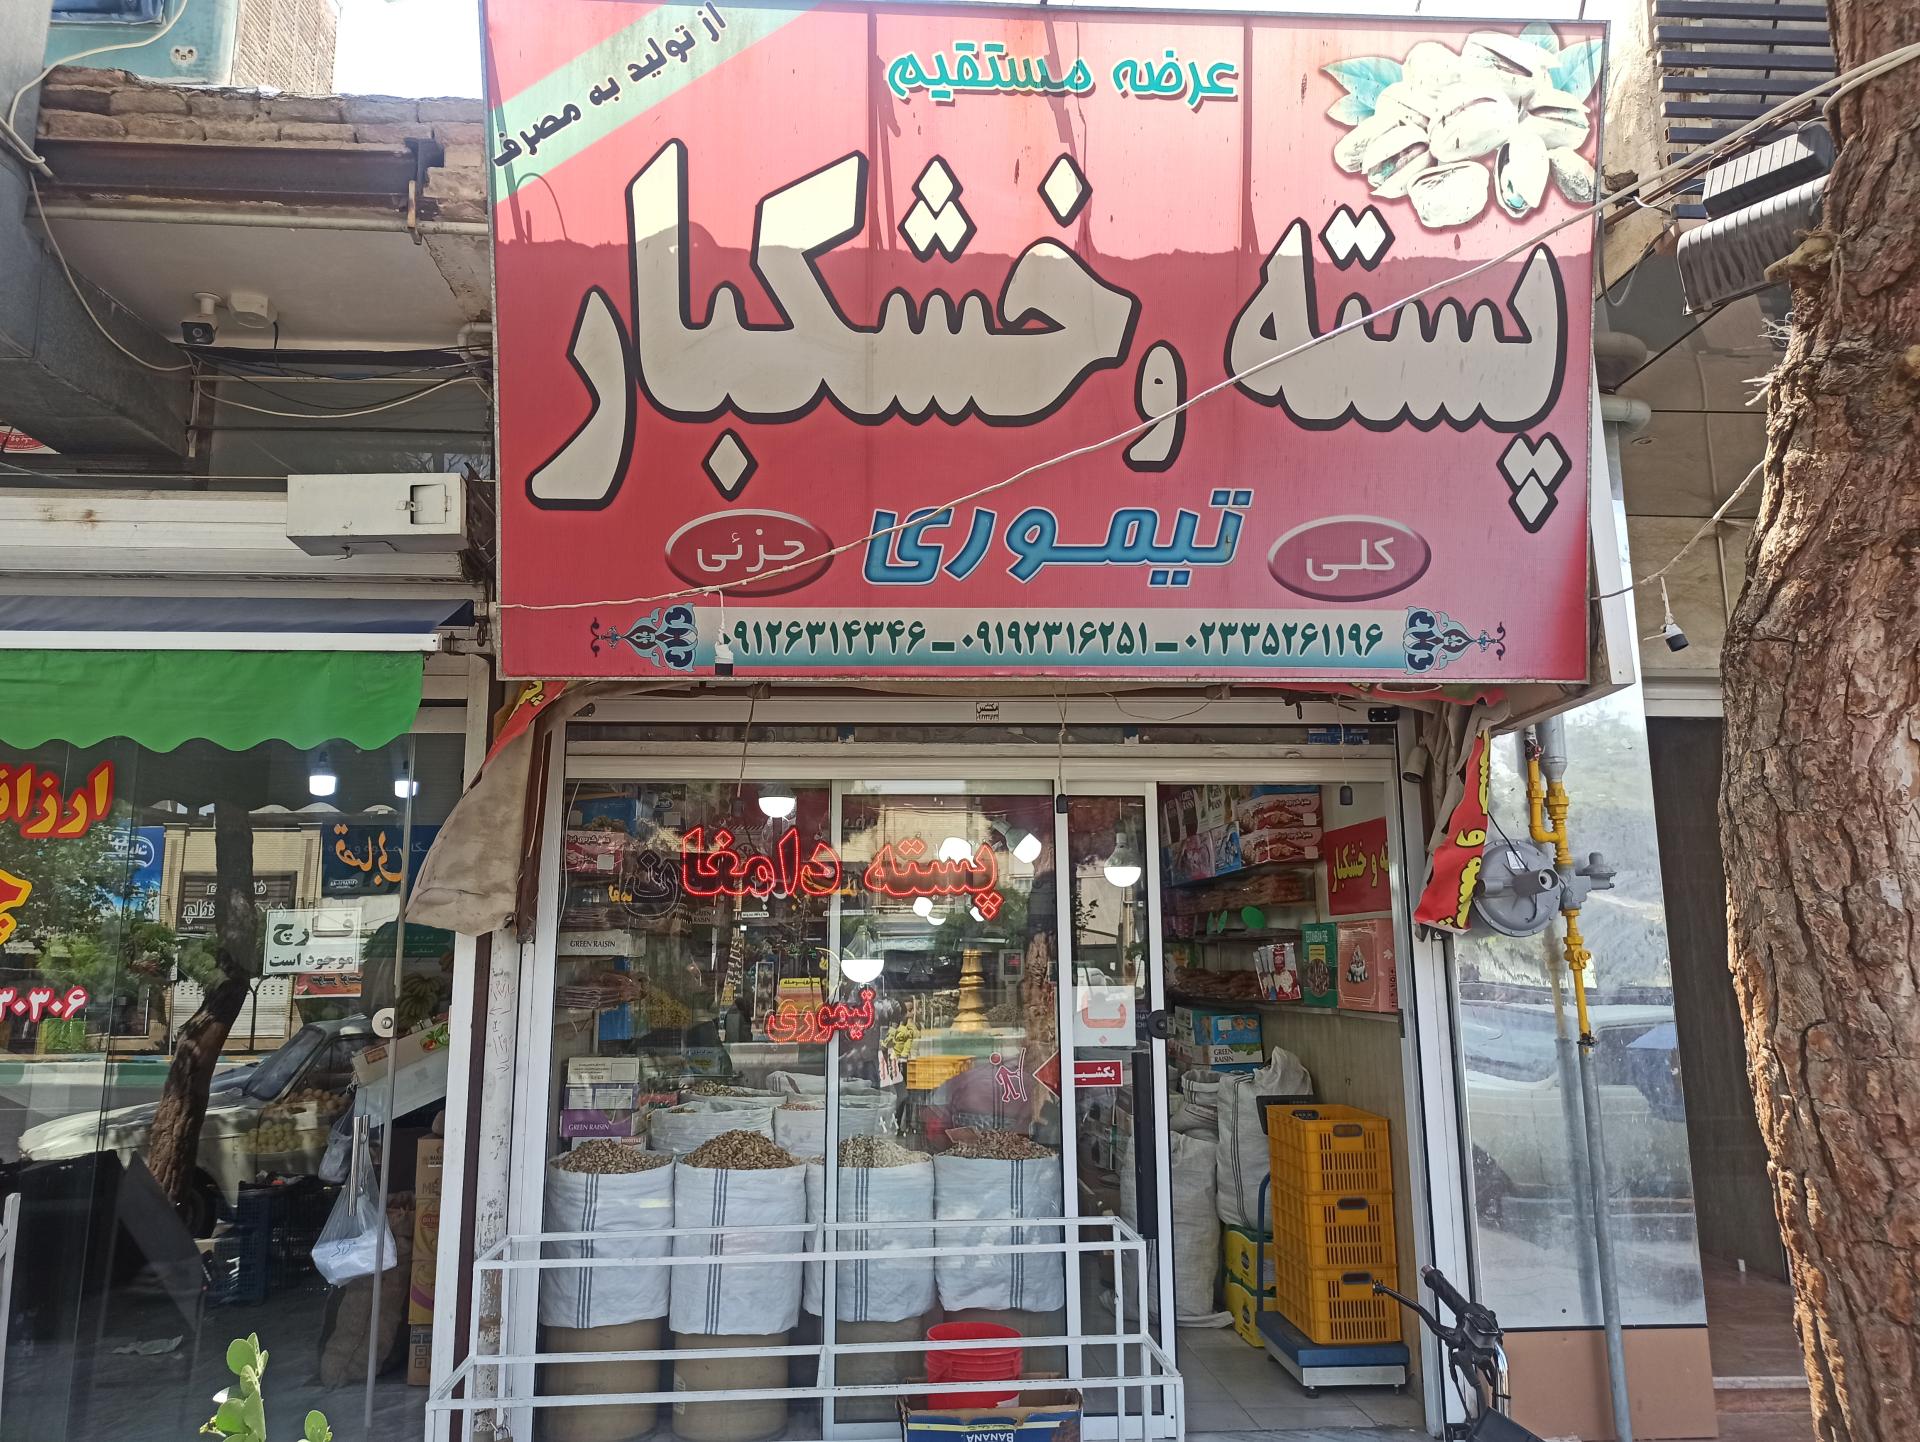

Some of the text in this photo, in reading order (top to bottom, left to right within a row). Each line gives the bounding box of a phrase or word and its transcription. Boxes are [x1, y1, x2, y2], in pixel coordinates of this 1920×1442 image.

[493, 1, 727, 167] از تولید به مصرف
[887, 41, 1238, 107] عرضه مستقیم
[524, 137, 1573, 534] پسته و خشکبار
[696, 527, 807, 573] جزئی
[861, 488, 1254, 588] تیموری
[1305, 537, 1396, 583] کلی
[863, 837, 1004, 921] پسته
[1331, 840, 1368, 894] خشکبار
[269, 951, 354, 971] موجود است
[569, 940, 616, 948] GREEN RAISIN
[765, 988, 875, 1044] تیموری
[1075, 1065, 1116, 1082] بکشی
[1213, 1048, 1234, 1056] GREEN
[1214, 1055, 1234, 1063] RAISIN
